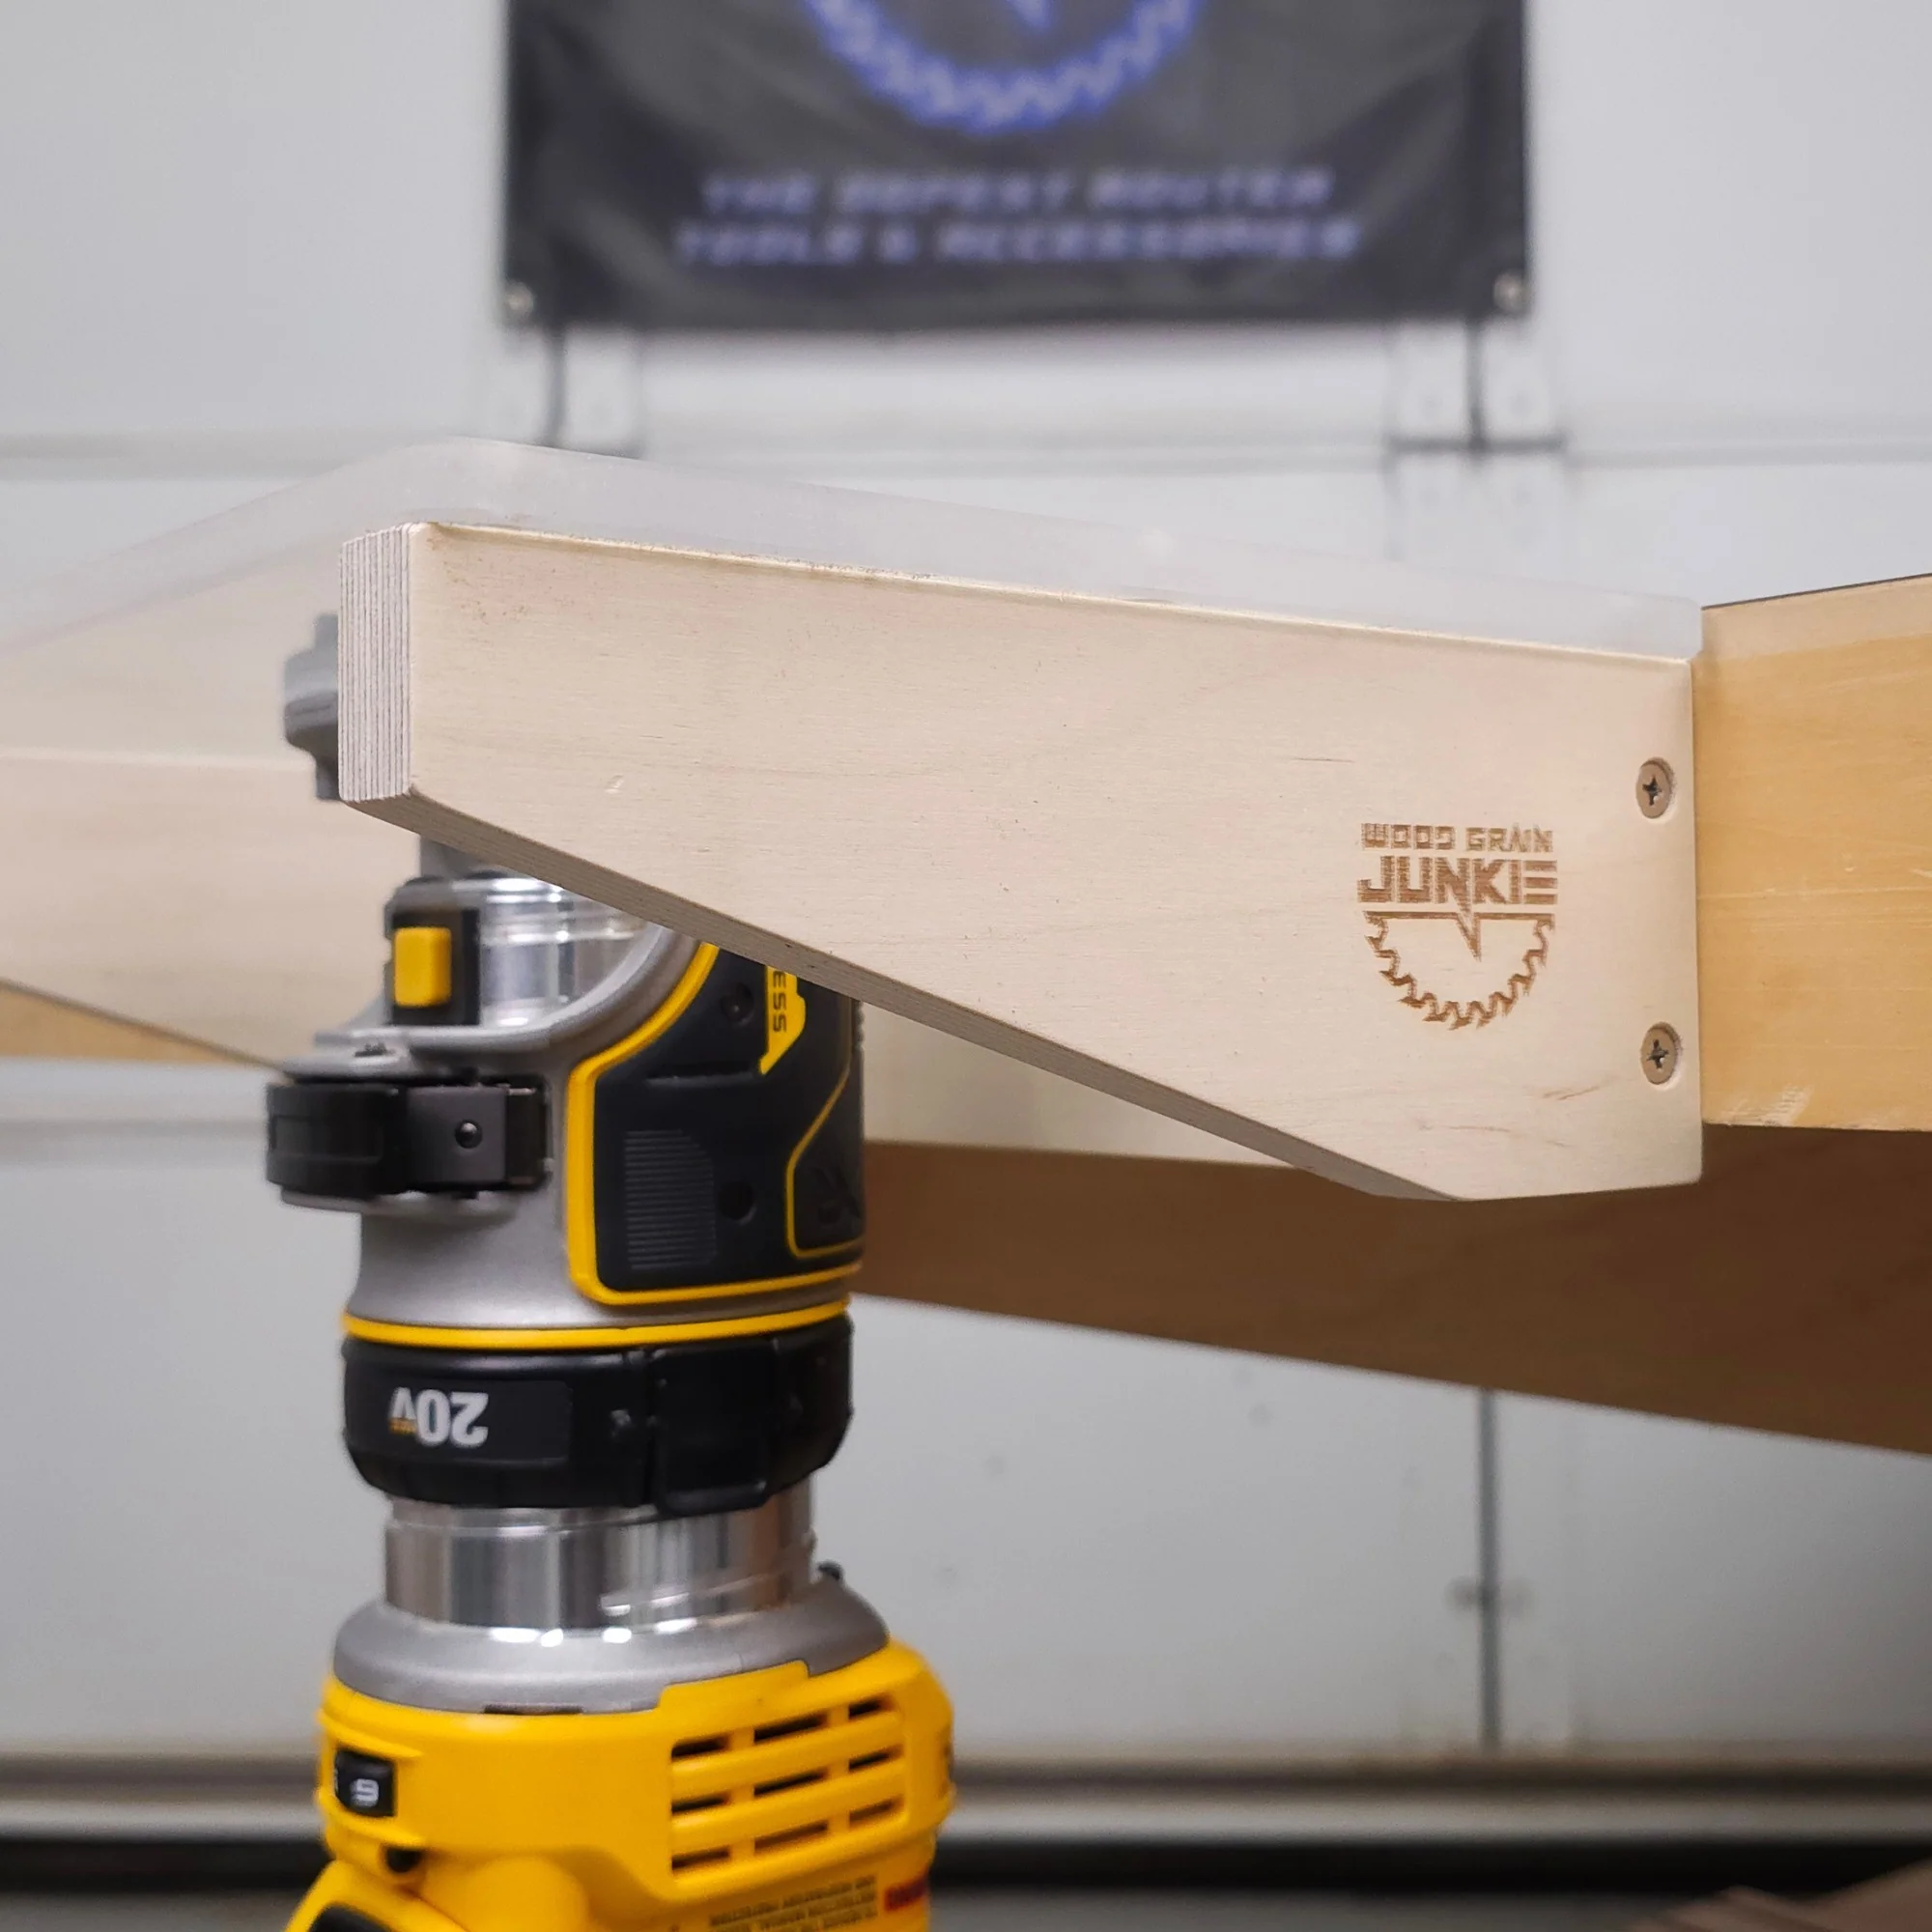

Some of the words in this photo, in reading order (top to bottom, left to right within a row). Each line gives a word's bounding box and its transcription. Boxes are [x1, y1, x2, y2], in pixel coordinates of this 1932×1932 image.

[1361, 823, 1456, 850] WOOD
[1465, 824, 1553, 852] GRAIN
[1357, 856, 1557, 910] JUNKIE
